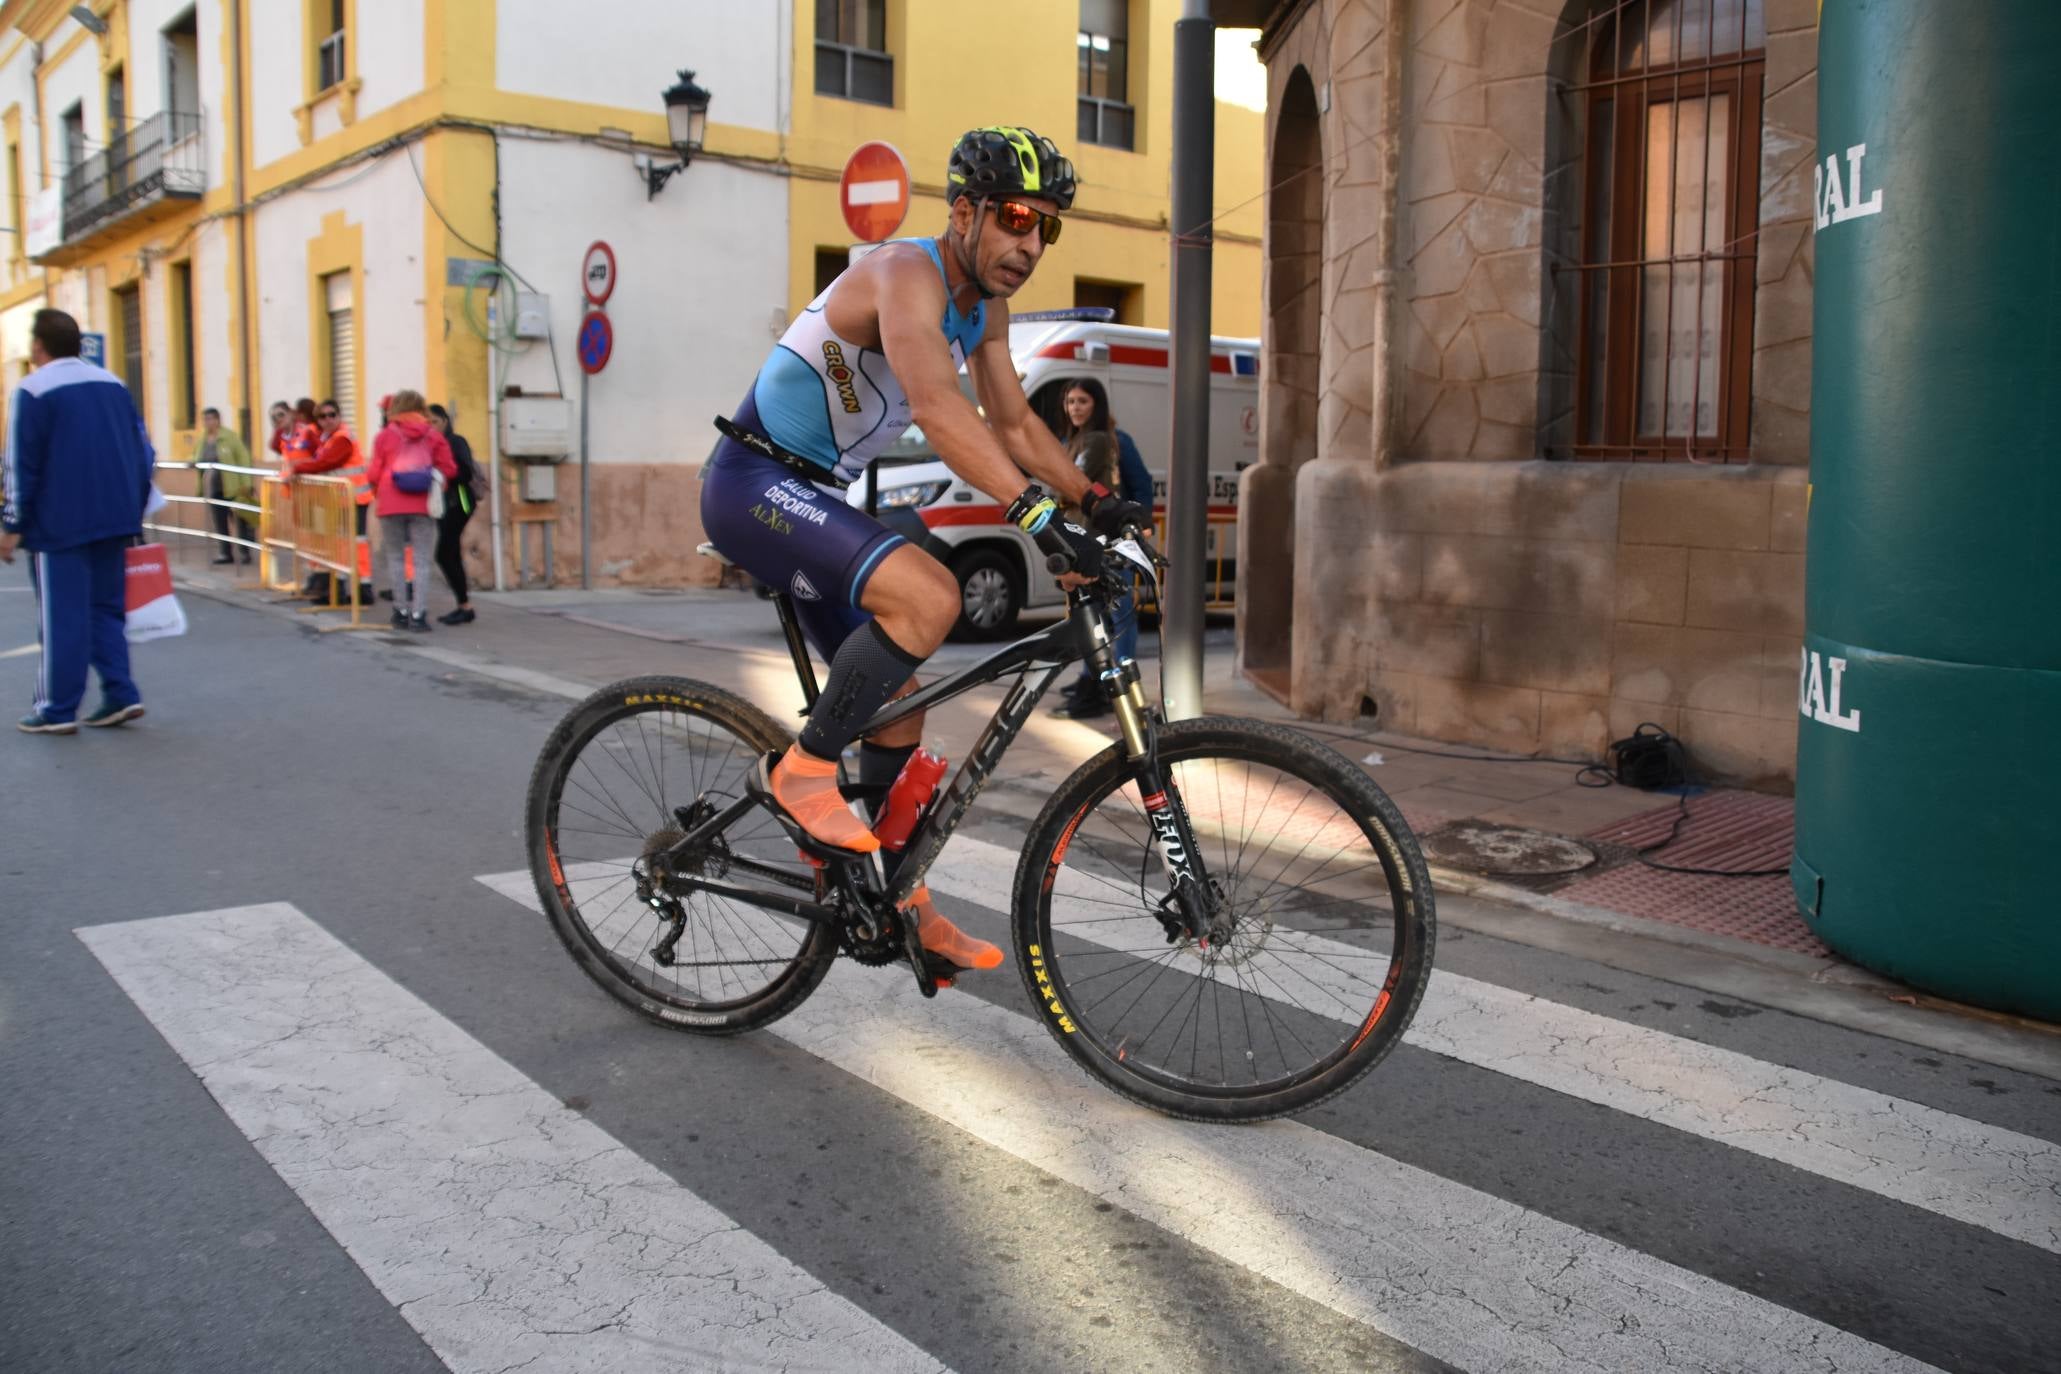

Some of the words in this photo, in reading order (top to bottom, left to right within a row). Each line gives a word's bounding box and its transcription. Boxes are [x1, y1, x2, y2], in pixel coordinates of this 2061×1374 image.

[822, 340, 862, 414] CROWN
[764, 485, 829, 526] DEPORTIVA
[780, 478, 818, 501] SALUD
[1151, 813, 1196, 882] FOX
[1029, 944, 1077, 1033] MAXXIS
